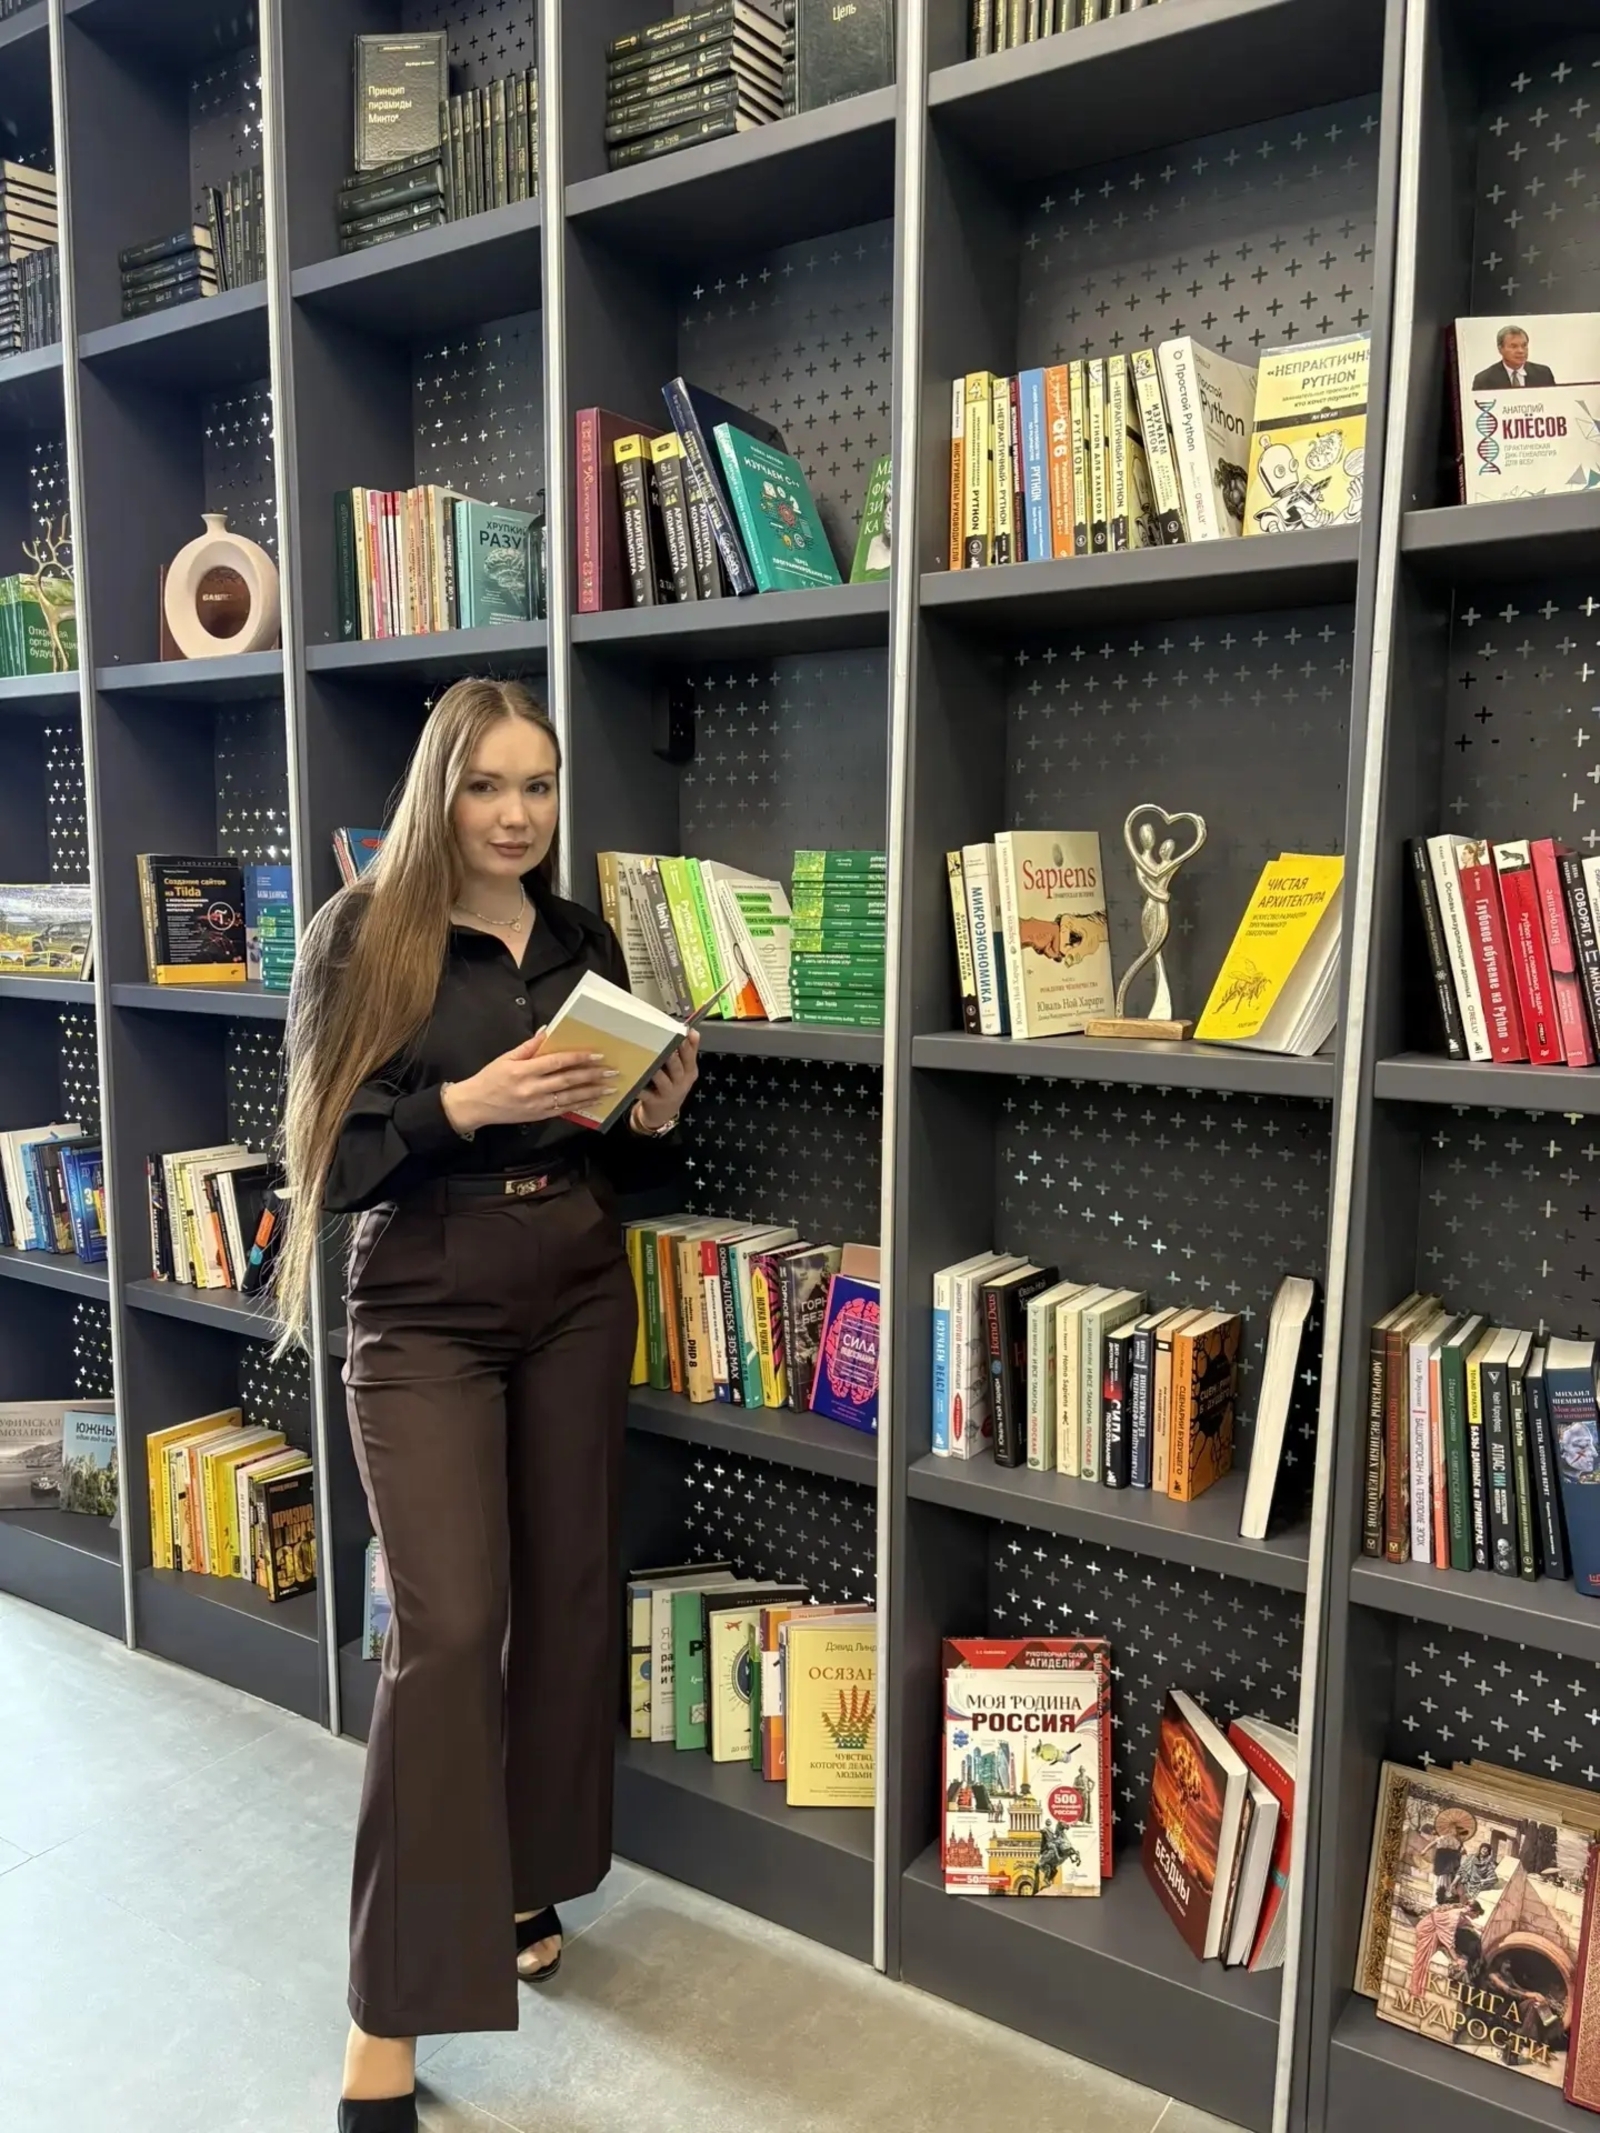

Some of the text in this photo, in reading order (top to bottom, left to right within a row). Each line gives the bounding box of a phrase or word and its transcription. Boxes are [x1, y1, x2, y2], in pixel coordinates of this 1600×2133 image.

[832, 3, 857, 21] Цель
[368, 85, 405, 98] Принцип
[368, 101, 412, 111] пирамиды
[1301, 369, 1356, 390] PYTHON
[1174, 364, 1195, 452] Простой Python
[1201, 391, 1245, 436] Python
[1502, 402, 1544, 415] АНАТОЛИЙ
[1144, 411, 1158, 454] PYTHON
[1151, 403, 1168, 455] ИЗУЧАЕМ
[1502, 413, 1567, 440] КЛЁСОВ
[1054, 446, 1064, 458] 6
[744, 457, 784, 482] ИЗУЧАЕМ
[1031, 466, 1040, 501] PYTHON
[1116, 471, 1124, 508] PYTHON
[480, 530, 522, 550] РАЗУ
[625, 511, 636, 575] КОМПЬЮТЕРА
[634, 509, 646, 572] АРХИТЕКТУРА
[665, 510, 679, 574] КОМПЬЮТЕРА
[674, 507, 688, 570] АРХИТЕКТУРА
[690, 505, 702, 571] КОМПЬЮТЕРА
[699, 503, 712, 567] АРХИТЕКТУРА
[864, 519, 880, 535] КА
[952, 501, 960, 562] РУКОВОДИТЕЛЯ
[164, 878, 199, 886] Создание
[174, 886, 201, 897] Tilda
[1022, 859, 1096, 899] Sapiens
[1267, 877, 1309, 892] ЧИСТАЯ
[655, 902, 669, 931] Unity
[1257, 891, 1326, 909] АРХИТЕКТУРА
[1546, 889, 1560, 945] Выгорание
[1574, 887, 1592, 940] ГОВОРЯТ,
[682, 900, 693, 935] Python
[955, 912, 964, 951] ПРОЕКТОВ
[971, 886, 992, 1004] МИКРОЭКОНОМИКА
[1429, 932, 1442, 967] ВСЕЛЕННОЙ
[1444, 881, 1473, 999] Основы визуализации данных
[1520, 912, 1541, 991] Python сложных
[1475, 898, 1509, 1039] Глубокое обучение на Python
[1037, 996, 1104, 1012] Юваль Ной Харари
[721, 1280, 734, 1333] AUTODESK
[781, 1280, 792, 1364] ГОРНОЕ БЕЗУМИЕ
[955, 1283, 963, 1342] ДИНОЗАВРЫ ПРОТИВ
[988, 1293, 997, 1321] Deus
[757, 1296, 769, 1356] НАУКА ЧУЖИХ
[991, 1322, 1000, 1355] Homo
[688, 1339, 697, 1357] PHP
[727, 1334, 736, 1356] 3DS
[843, 1333, 876, 1356] СИЛА
[935, 1319, 946, 1393] ИЗУЧАЕМ REACT
[729, 1357, 739, 1380] MAX
[994, 1377, 1002, 1405] Харари
[1062, 1380, 1070, 1407] Sapiens
[1552, 1397, 1595, 1405] ШЕМЯКИН
[0, 1418, 61, 1427] УФИМСКАЯ
[0, 1428, 54, 1437] МОЗАИКА
[76, 1422, 116, 1436] ЮЖНЫ
[996, 1422, 1004, 1446] Юваль
[1112, 1399, 1121, 1442] СИЛА
[1176, 1385, 1187, 1475] СЦЕНАРИИ БУДУЩЕГО
[1495, 1403, 1503, 1432] Кроуфорд
[1106, 1411, 1114, 1467] ПОДСОЗНАНИЯ
[1131, 1427, 1139, 1479] ГРАВИТАЦИЯ
[1368, 1359, 1383, 1527] АФОРИЗМЫ ВЕЛИКИХ ПЕДАГОГОВ
[1515, 1429, 1523, 1447] Python
[1389, 1397, 1399, 1529] ИСТОРИЯ РОССИИ ДЕТЕЙ
[1492, 1442, 1507, 1487] АТЛАС ИИ
[1538, 1444, 1546, 1476] КОТОРЫМ
[1415, 1417, 1425, 1547] БАШКОРТОСТАН НА ПЕРЕЛОМЕ ЭПОХ
[1471, 1425, 1484, 1545] БАЗЫ ДАННЫХ ПРИМЕРАХ
[825, 1641, 853, 1653] Дэвид
[1025, 1657, 1080, 1669] «АГИДЕЛИ»
[966, 1694, 1082, 1711] МОЯ РОДИНА
[972, 1712, 1077, 1734] РОССИЯ
[810, 1762, 847, 1770] КОТОРОЕ
[835, 1771, 873, 1780] ЛЮДЬМИ
[1054, 1794, 1077, 1804] 500
[967, 1875, 979, 1884] 50
[1154, 1837, 1190, 1905] БЕЗДНЫ
[1425, 1972, 1523, 2024] КНИГА
[1392, 1989, 1551, 2067] МУДРОСТИ
